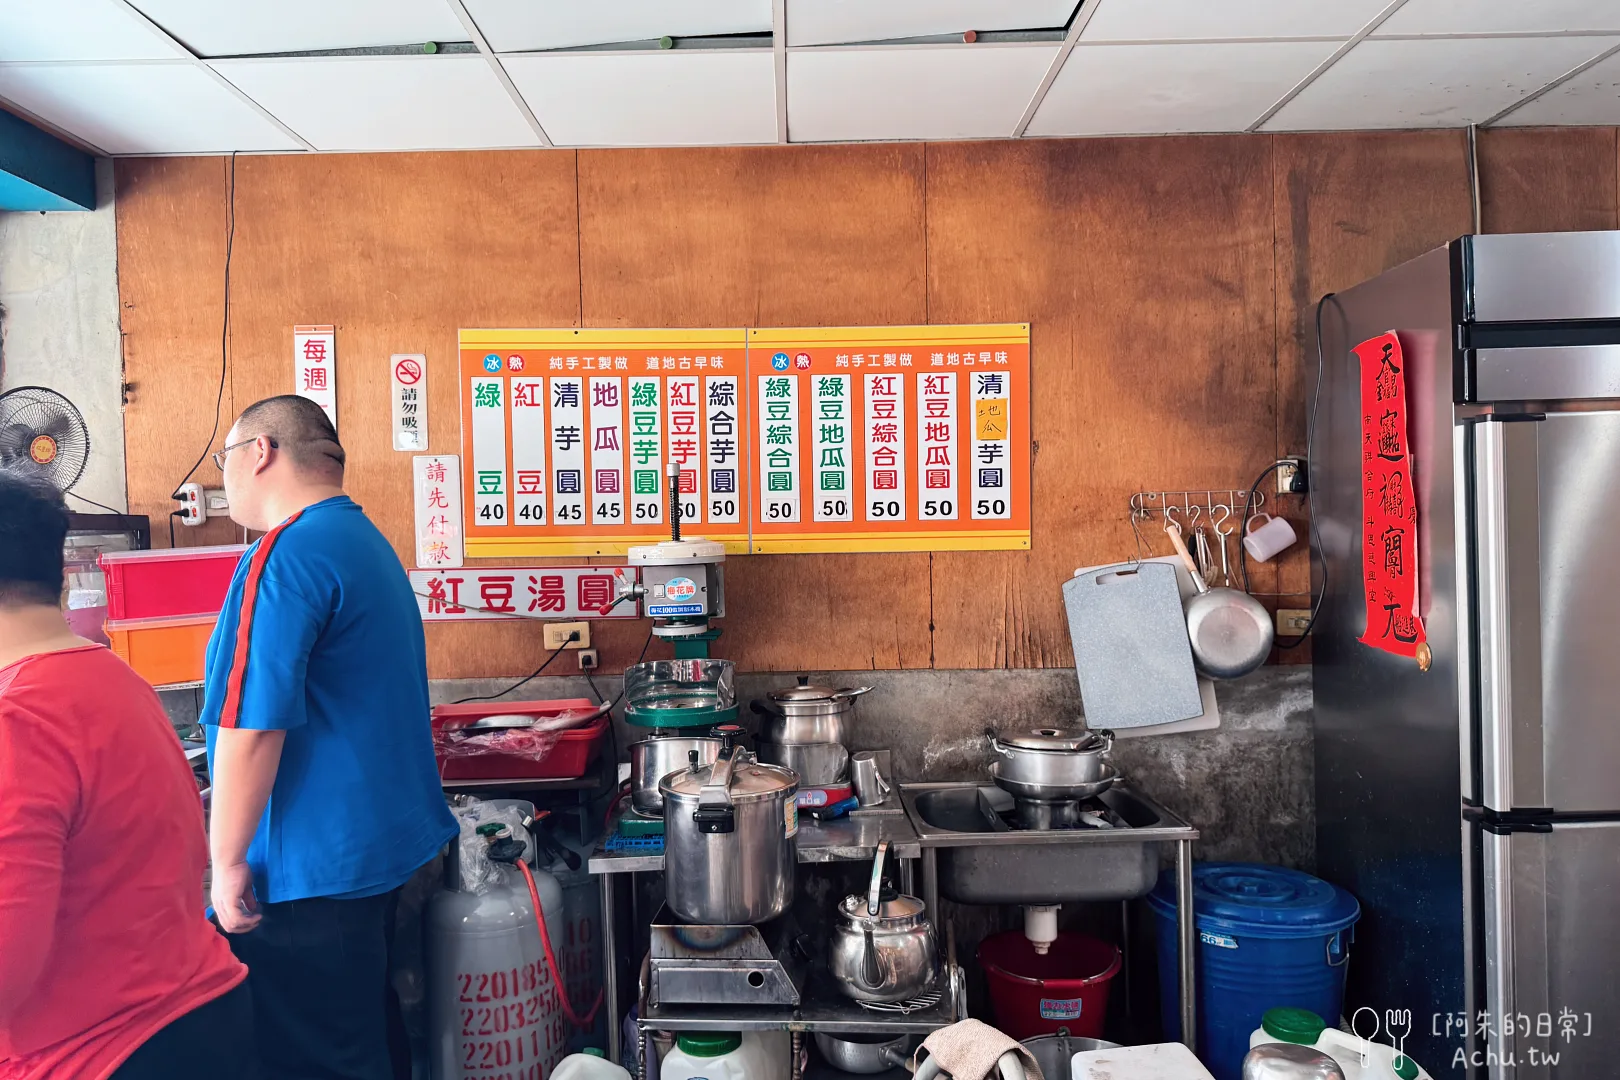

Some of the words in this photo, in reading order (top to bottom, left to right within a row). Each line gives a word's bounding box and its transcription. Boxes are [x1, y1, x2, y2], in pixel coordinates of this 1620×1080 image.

[486, 356, 500, 370] 冰
[508, 356, 523, 370] 熱
[549, 356, 628, 370] 純手工製做
[646, 355, 725, 370] 道地古早味
[774, 354, 788, 368] 冰
[796, 354, 811, 368] 熱
[835, 352, 913, 368] 純手工製做
[930, 351, 1009, 366] 道地古早味
[553, 382, 581, 494] 清芋圓
[593, 382, 620, 494] 地瓜圓
[631, 381, 659, 494] 綠豆芋圓
[670, 381, 697, 494] 紅豆芋圓
[709, 381, 736, 494] 綜合芋圓
[765, 377, 793, 491] 綠豆綜合圓
[818, 376, 845, 490] 綠豆地瓜圓
[871, 376, 898, 489] 紅豆綜合圓
[924, 375, 951, 489] 紅豆地瓜圓
[425, 461, 451, 562] 請先付款
[480, 503, 504, 520] 40
[519, 504, 543, 520] 40
[557, 504, 582, 520] 45
[596, 502, 621, 518] 45
[635, 503, 658, 519] 50
[712, 500, 735, 516] 50
[769, 502, 792, 518] 50
[823, 500, 845, 516] 50
[871, 501, 900, 517] 50
[924, 500, 953, 516] 50
[976, 499, 1005, 515] 50
[427, 575, 614, 614] 紅豆湯圓
